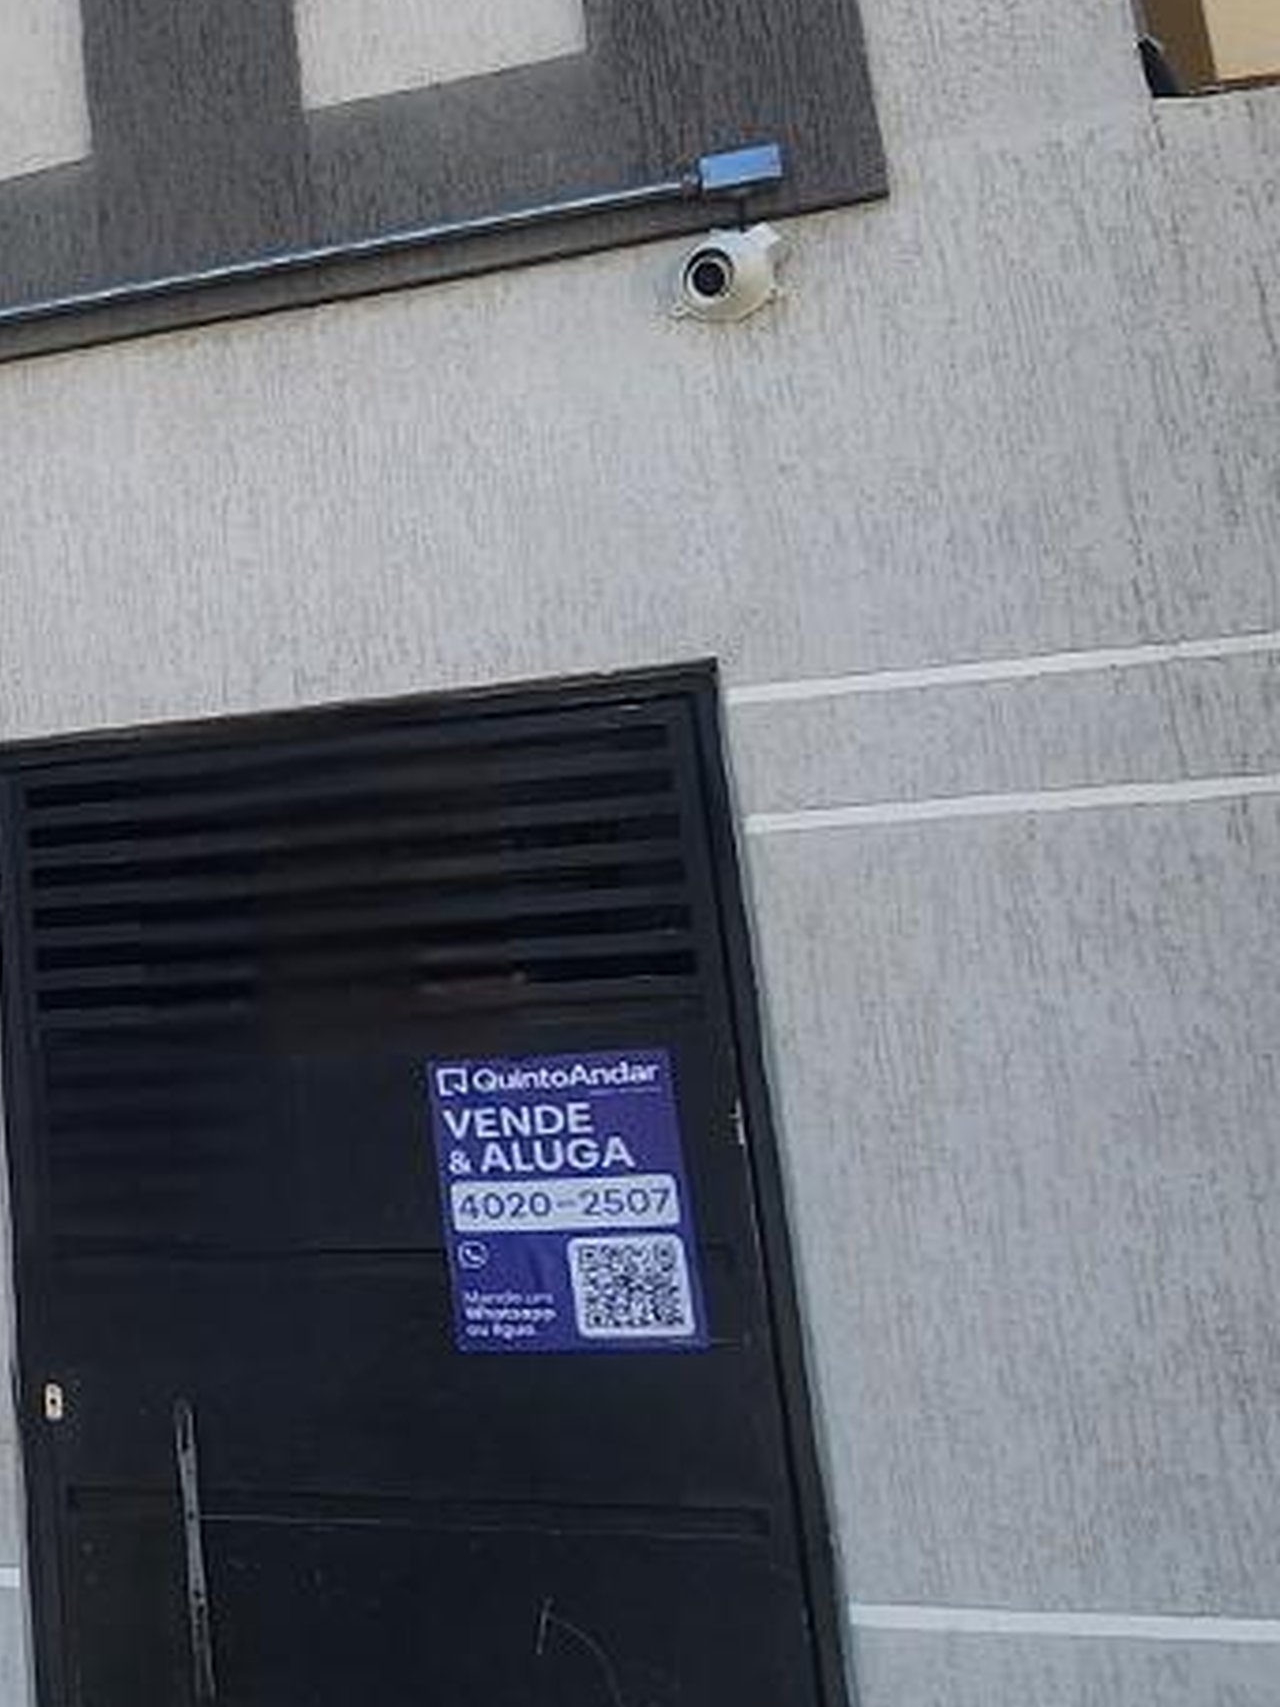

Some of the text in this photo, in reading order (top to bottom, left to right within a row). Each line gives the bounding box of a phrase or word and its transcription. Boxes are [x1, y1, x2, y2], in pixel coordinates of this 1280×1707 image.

[472, 1062, 659, 1091] QuintoAndar
[443, 1102, 594, 1139] VENDE
[449, 1136, 636, 1174] & ALUGA
